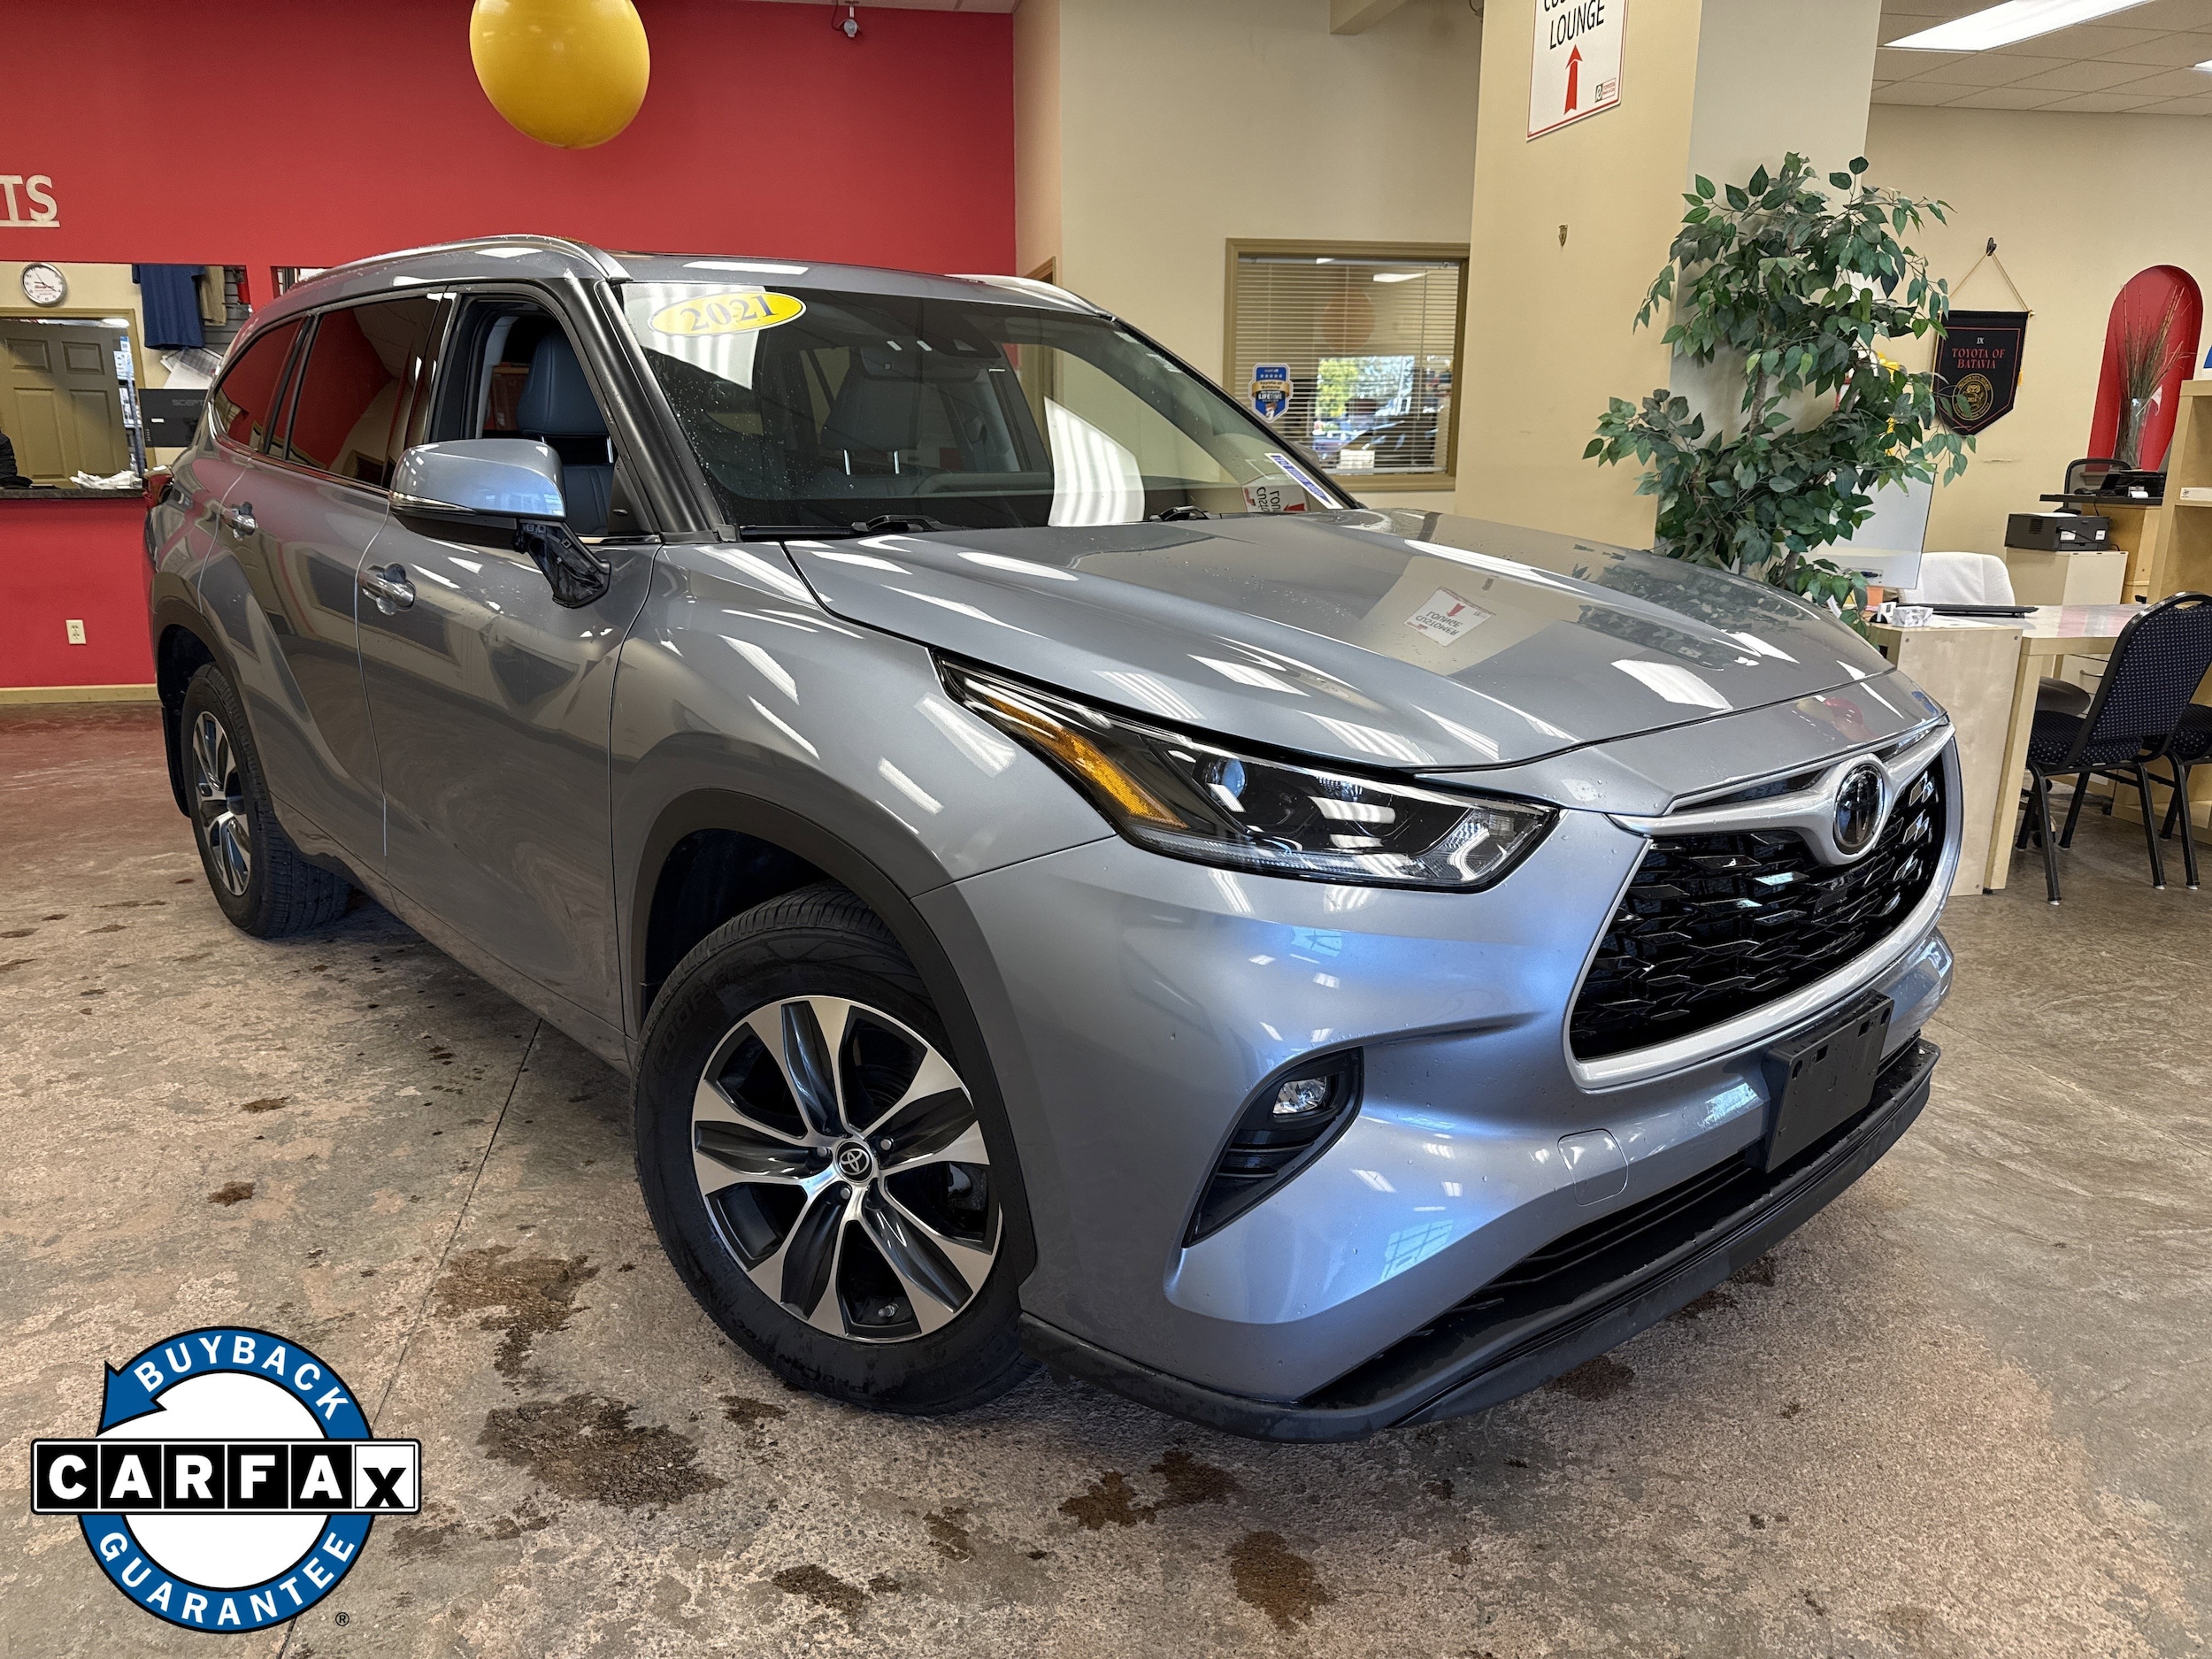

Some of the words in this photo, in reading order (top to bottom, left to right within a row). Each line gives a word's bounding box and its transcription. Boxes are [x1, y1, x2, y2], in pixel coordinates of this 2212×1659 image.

[1550, 0, 1605, 50] LOUNGE
[680, 295, 778, 332] 2021
[1952, 349, 1989, 358] TOYOTA
[1993, 349, 2006, 358] OF
[1957, 359, 1996, 369] BATAVIA
